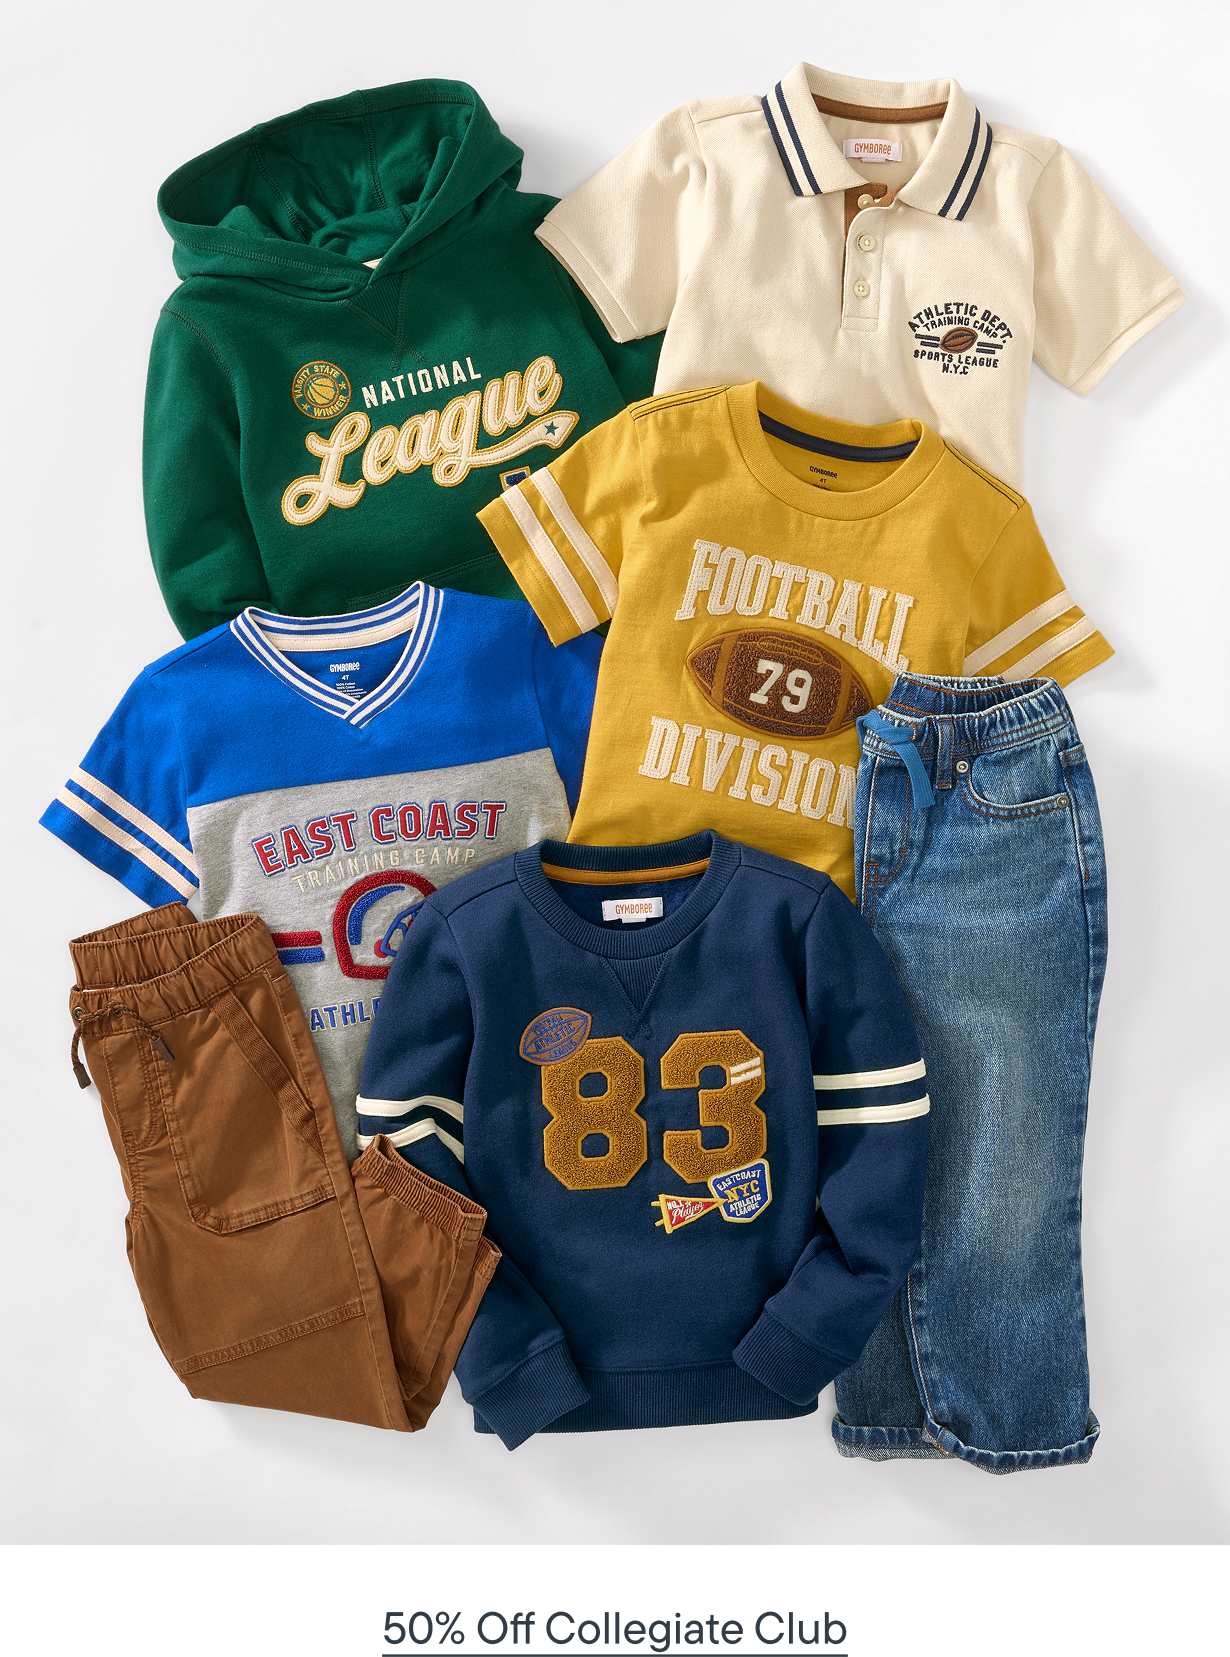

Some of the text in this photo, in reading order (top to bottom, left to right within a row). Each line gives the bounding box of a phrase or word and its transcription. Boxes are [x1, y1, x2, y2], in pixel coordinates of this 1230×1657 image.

[908, 302, 1013, 344] ATHLETIC DEPT.
[923, 316, 998, 339] TRAINING CAMP
[313, 365, 339, 378] STATE
[913, 349, 1000, 368] SPORTS LEAGUE
[361, 356, 482, 409] NATIONAL
[313, 395, 347, 416] WINNER
[281, 355, 563, 526] League
[674, 538, 914, 676] FOOTBALL
[749, 658, 813, 714] 79
[251, 801, 506, 878] EAST COAST
[292, 847, 477, 894] TRAINING CAMP
[540, 1029, 768, 1191] 83
[724, 1180, 760, 1203] NYC
[729, 1193, 762, 1213] ATHLETIC
[735, 1202, 760, 1217] LEAGUE
